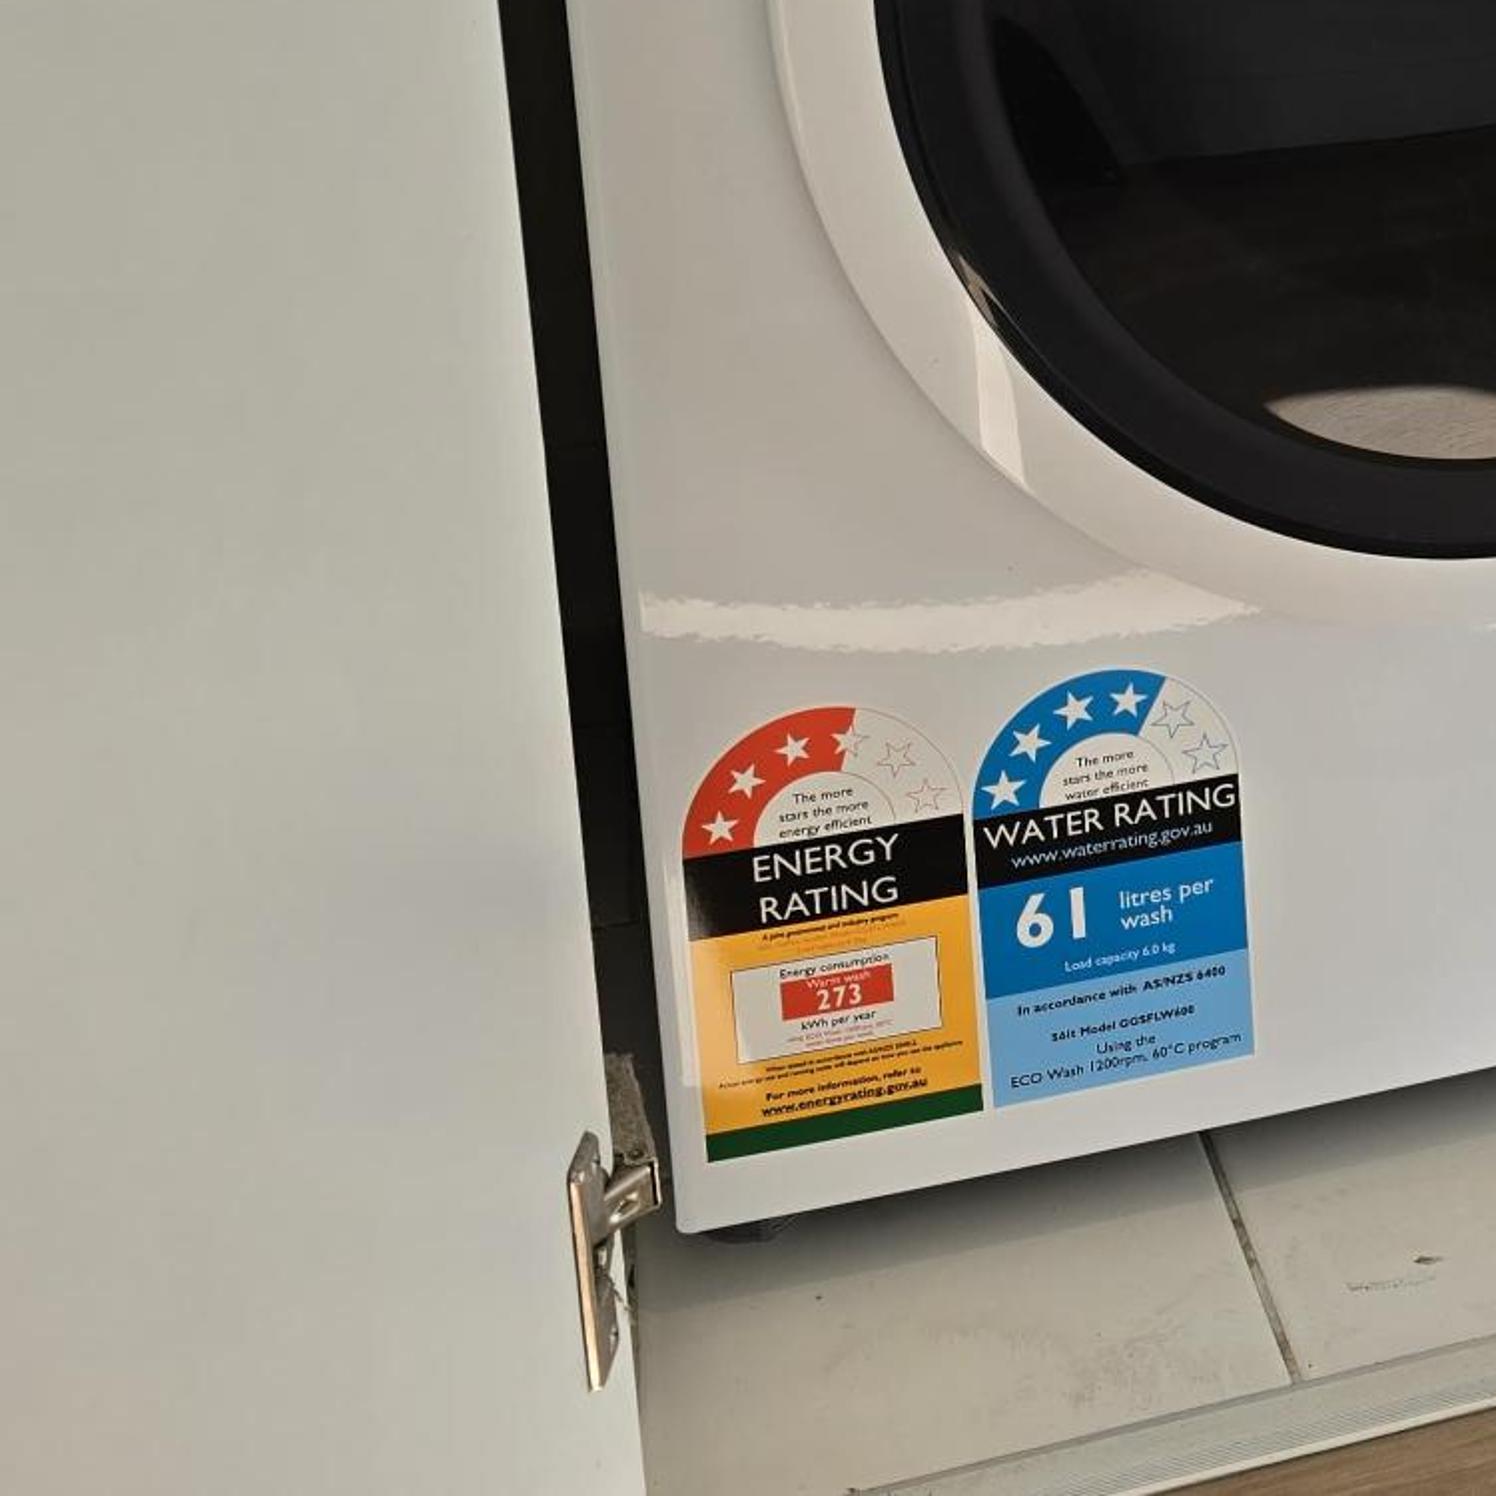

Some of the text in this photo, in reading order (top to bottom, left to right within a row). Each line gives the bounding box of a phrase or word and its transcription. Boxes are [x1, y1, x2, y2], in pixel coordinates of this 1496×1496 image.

[1076, 751, 1133, 768] The more
[1063, 764, 1148, 786] stars the more
[792, 788, 853, 804] The more
[1065, 779, 1149, 801] water efficient
[779, 801, 869, 823] stars the more
[983, 783, 1236, 850] WATER RATING
[779, 816, 872, 838] energy efficient
[752, 833, 899, 883] ENERGY
[1011, 821, 1213, 869] www.waterrating.gov.au
[759, 876, 900, 923] RATING
[1119, 878, 1215, 909] litres per
[1016, 886, 1087, 949] 61
[1120, 904, 1174, 930] wash
[779, 953, 890, 979] Energy consumption
[1064, 956, 1092, 973] Load
[1095, 948, 1140, 967] capacity
[1162, 941, 1176, 955] kg
[816, 983, 862, 1011] 273
[1017, 1004, 1030, 1017] In
[1034, 991, 1106, 1014] accordance
[1109, 983, 1137, 998] with
[801, 1017, 829, 1031] kWh
[831, 1015, 849, 1028] per
[853, 1010, 877, 1024] year
[1080, 1020, 1116, 1037] Model
[1096, 1034, 1156, 1054] Using the
[1010, 1071, 1042, 1089] ECO
[1047, 1065, 1084, 1081] Wash
[1188, 1033, 1242, 1055] program
[761, 1077, 928, 1116] www.energyrating.gov.au
[765, 1066, 922, 1102] For more information, refer to
